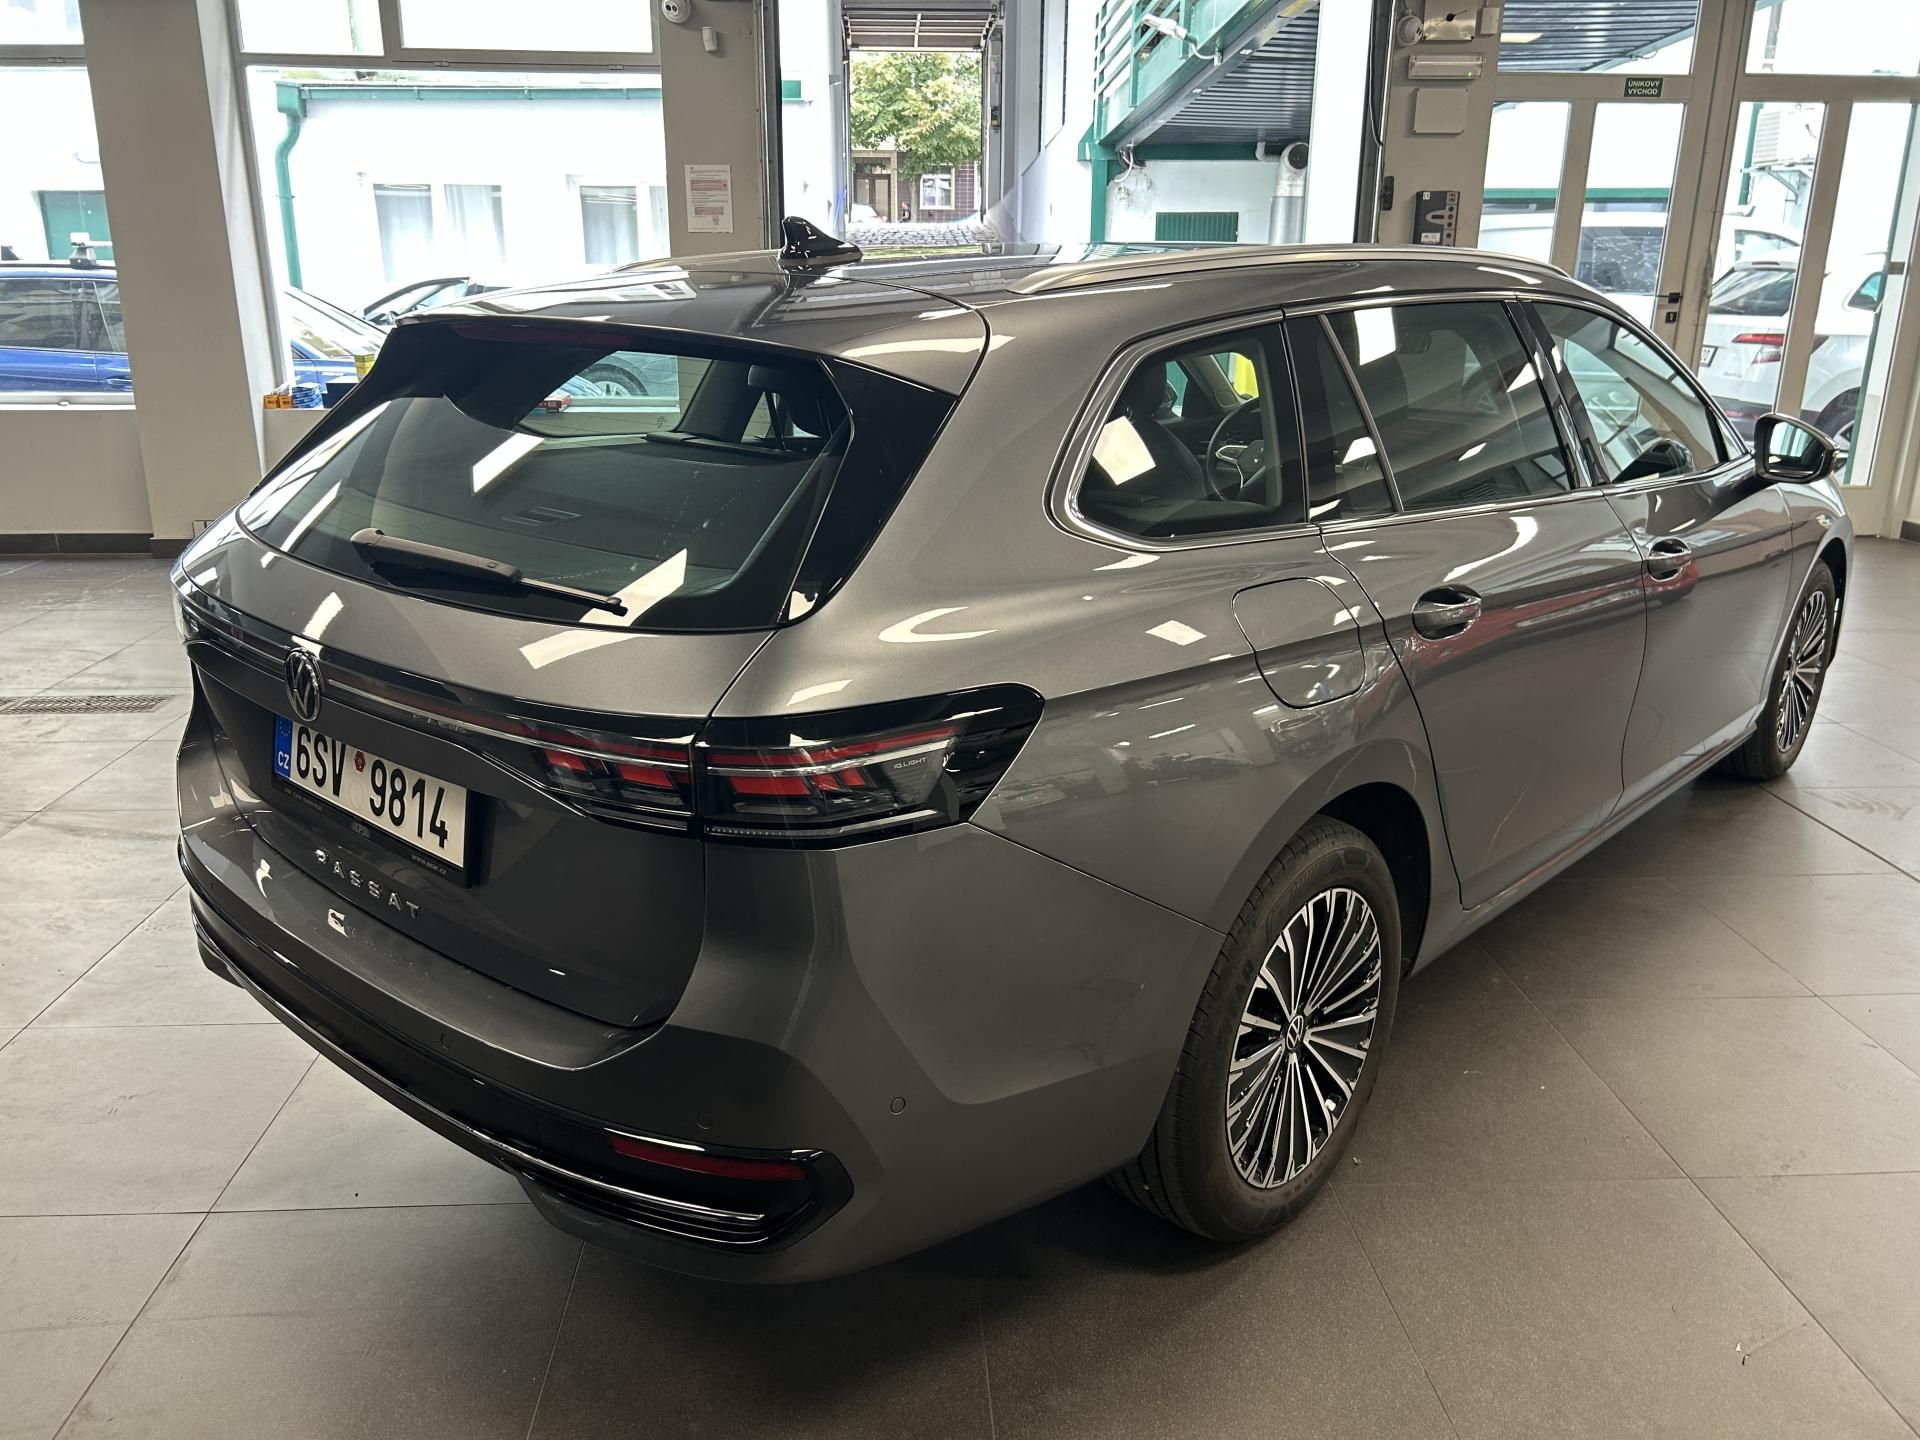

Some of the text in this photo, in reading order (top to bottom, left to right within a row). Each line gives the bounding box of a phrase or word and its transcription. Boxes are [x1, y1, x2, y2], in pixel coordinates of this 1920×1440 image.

[278, 750, 290, 770] CZ
[296, 725, 449, 849] 6SV 9814
[315, 848, 420, 919] PASSAT
